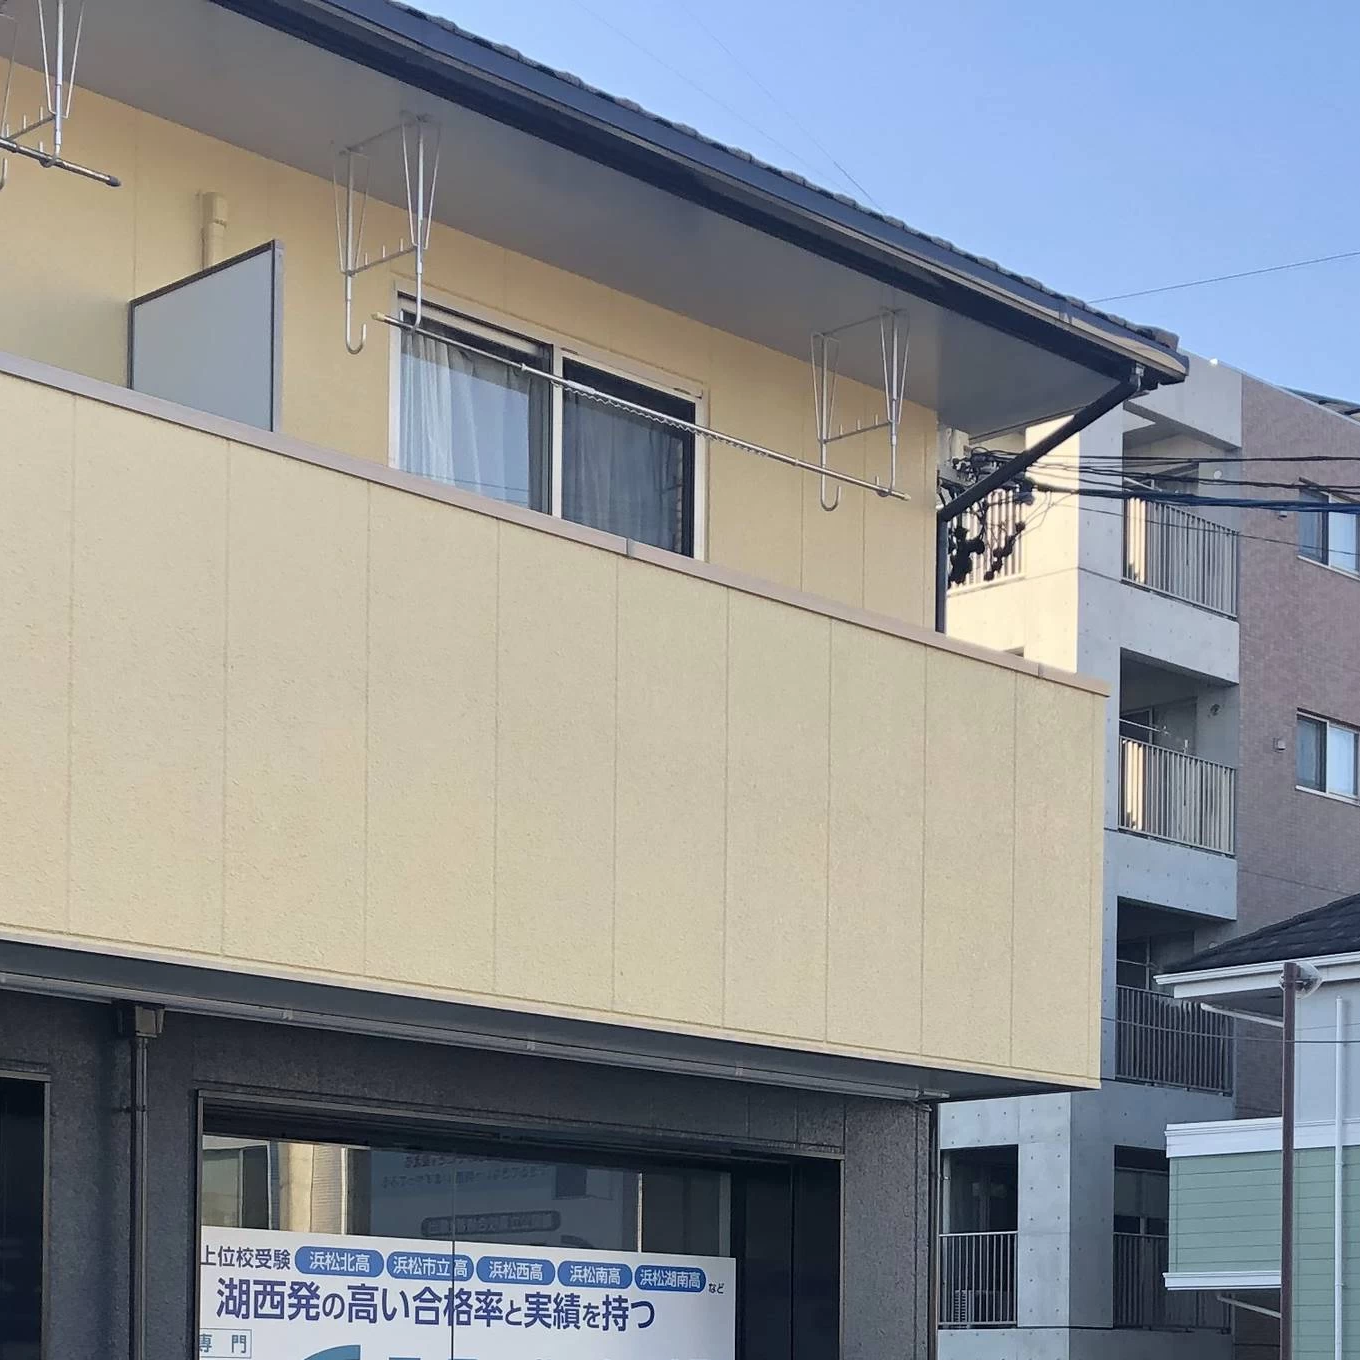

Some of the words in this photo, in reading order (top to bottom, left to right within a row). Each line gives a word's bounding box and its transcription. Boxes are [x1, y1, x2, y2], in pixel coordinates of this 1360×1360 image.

[200, 1245, 291, 1271] 上位校受験
[309, 1250, 371, 1273] 浜松北高
[392, 1256, 469, 1278] 浜松市立高
[488, 1260, 544, 1281] 浜松西高
[569, 1264, 622, 1285] 浜松南高
[639, 1269, 702, 1289] 浜松湖南高
[708, 1283, 725, 1295] など
[216, 1276, 656, 1332] 湖西発の高い合格率と実績を持つ
